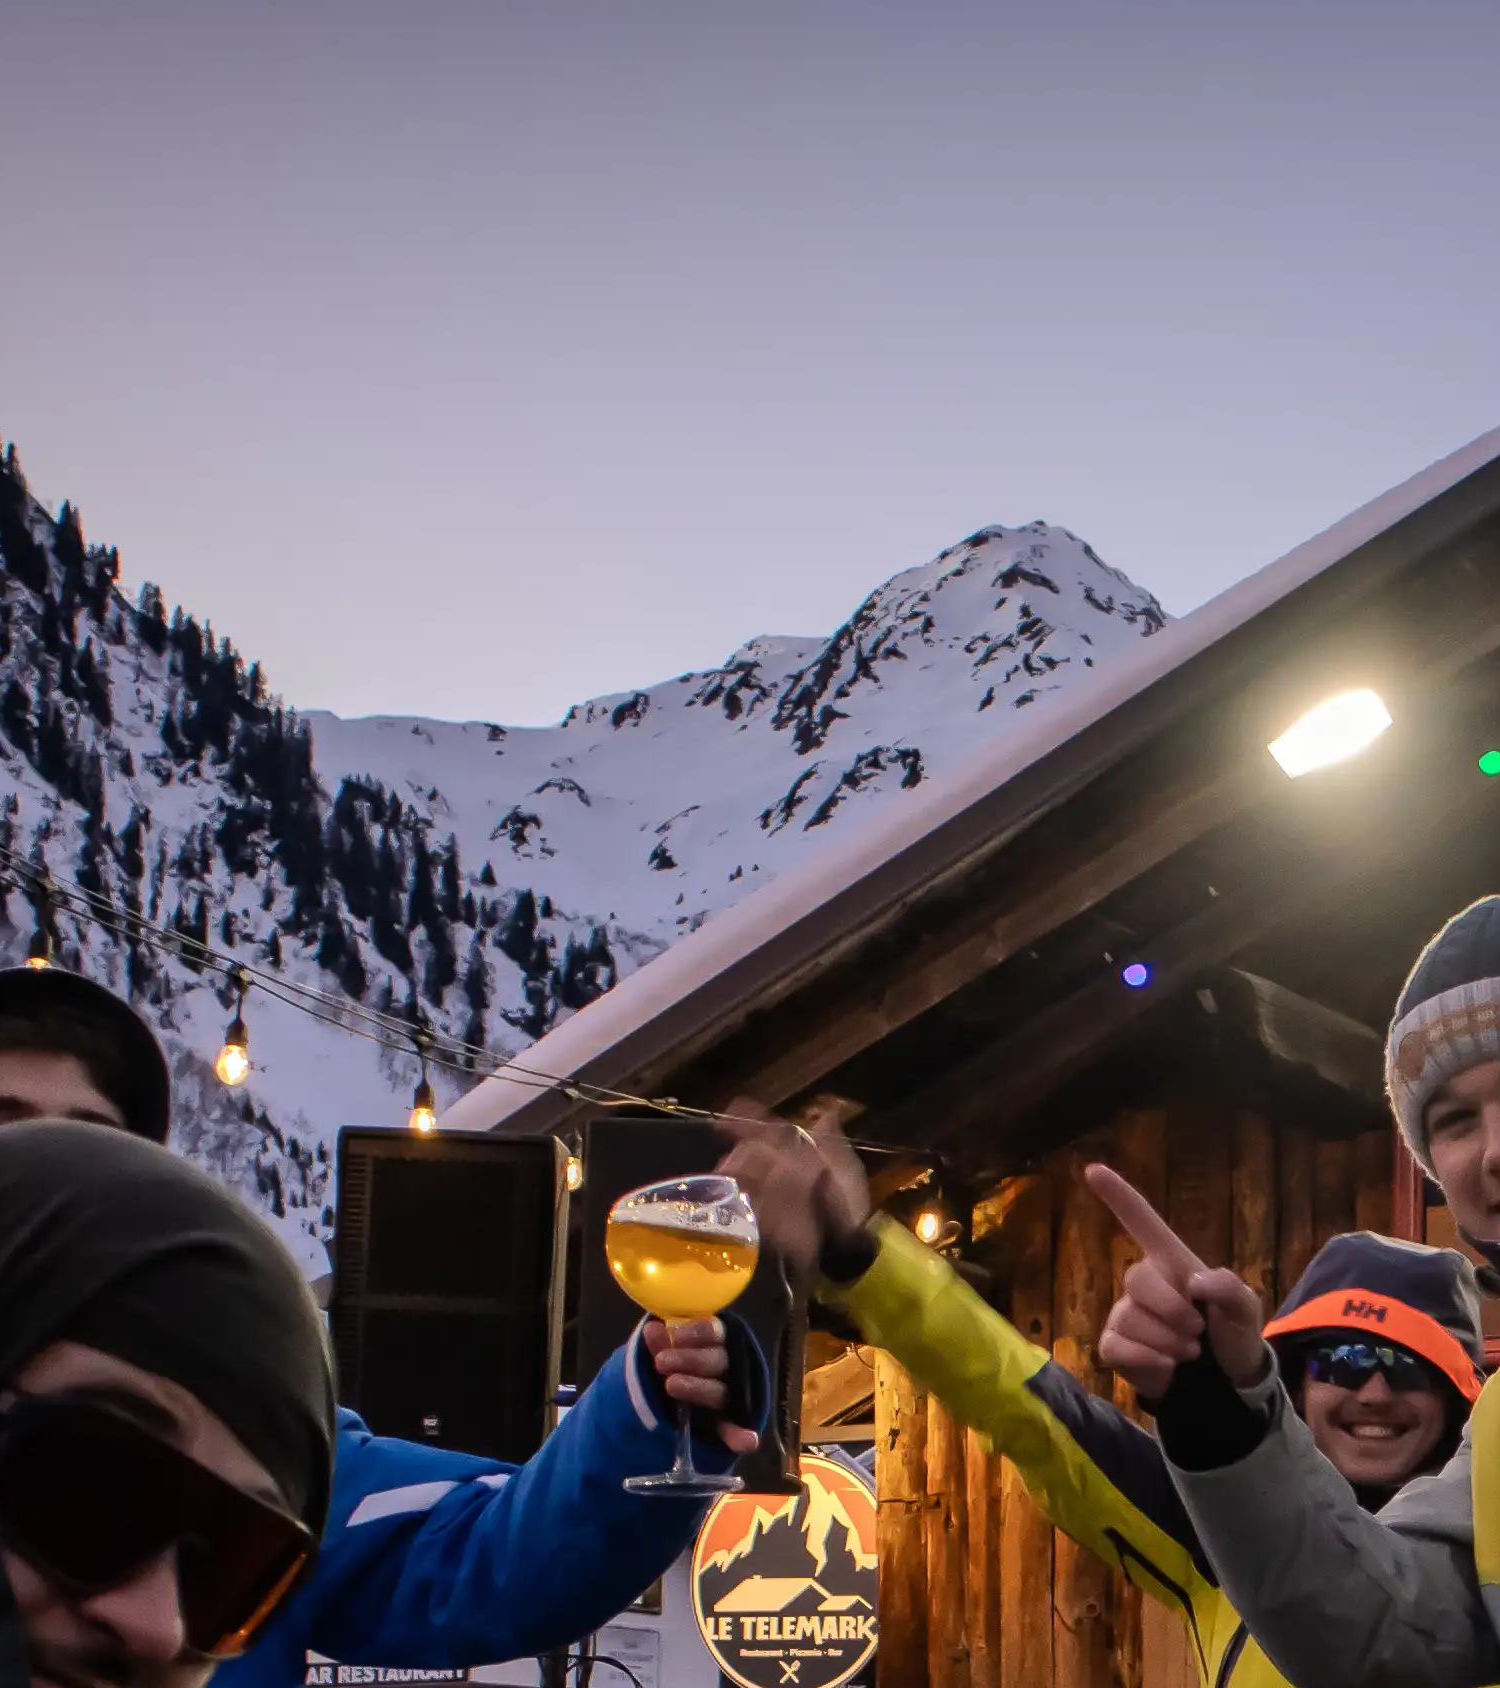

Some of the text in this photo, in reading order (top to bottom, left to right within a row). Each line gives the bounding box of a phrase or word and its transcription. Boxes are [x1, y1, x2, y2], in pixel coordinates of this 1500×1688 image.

[1343, 1300, 1388, 1322] HH
[705, 1615, 879, 1645] LE TELEMARK
[306, 1666, 334, 1685] AR
